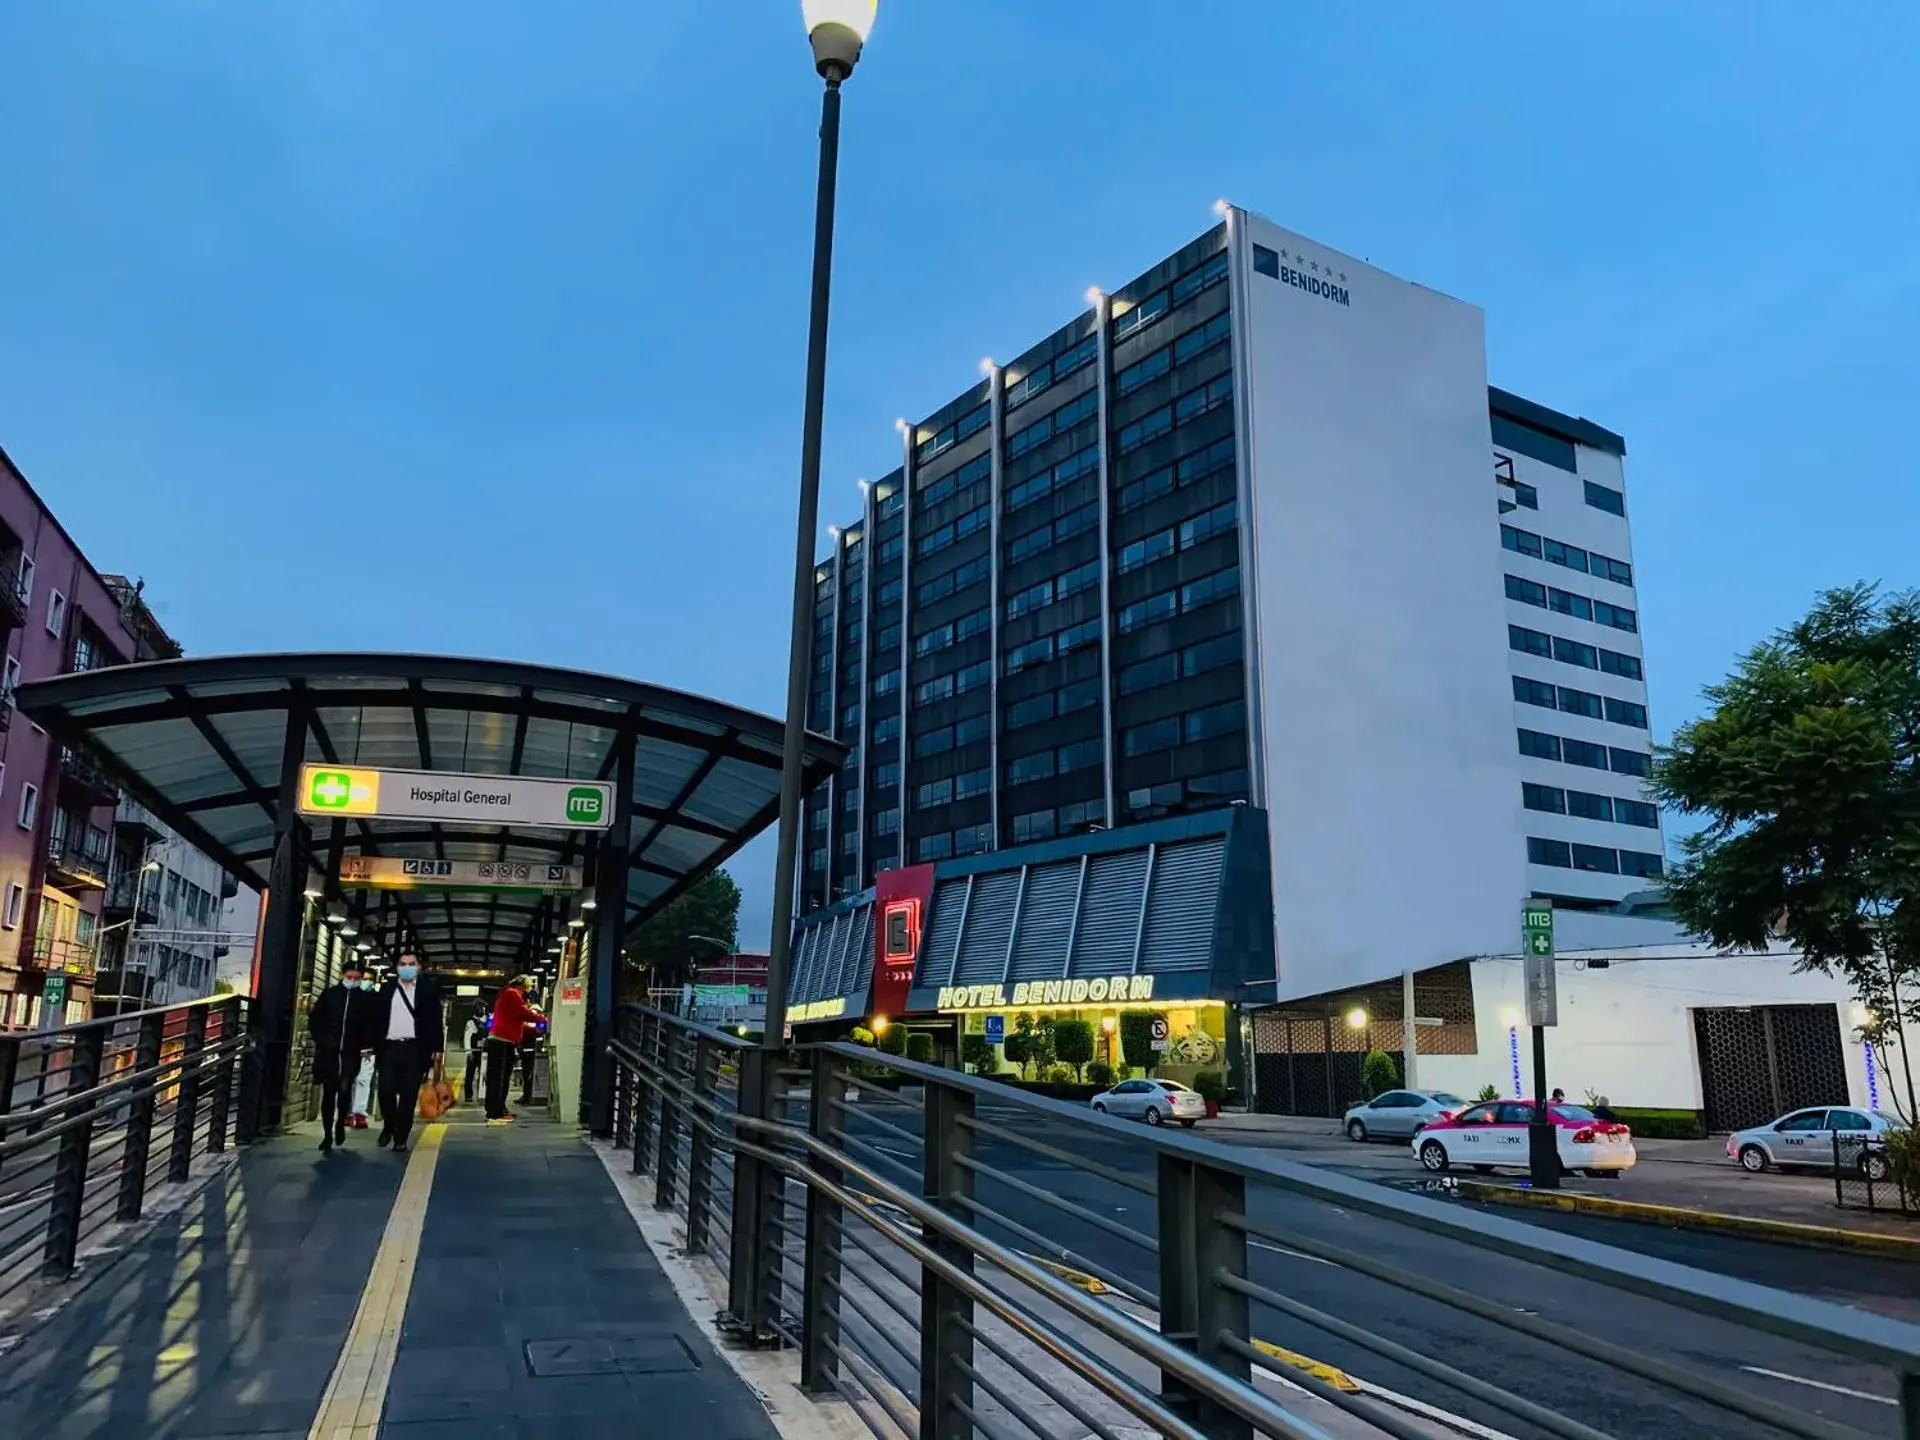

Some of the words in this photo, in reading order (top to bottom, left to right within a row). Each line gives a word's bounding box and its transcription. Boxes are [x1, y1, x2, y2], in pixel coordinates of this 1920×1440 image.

[1280, 266, 1350, 306] BENIDORM
[410, 787, 460, 804] Hospital
[463, 790, 511, 805] General
[937, 984, 1007, 1008] HOTEL
[1012, 975, 1154, 1005] BENIDORM
[1463, 1134, 1480, 1143] TAXI
[1785, 1138, 1804, 1146] TAXI
